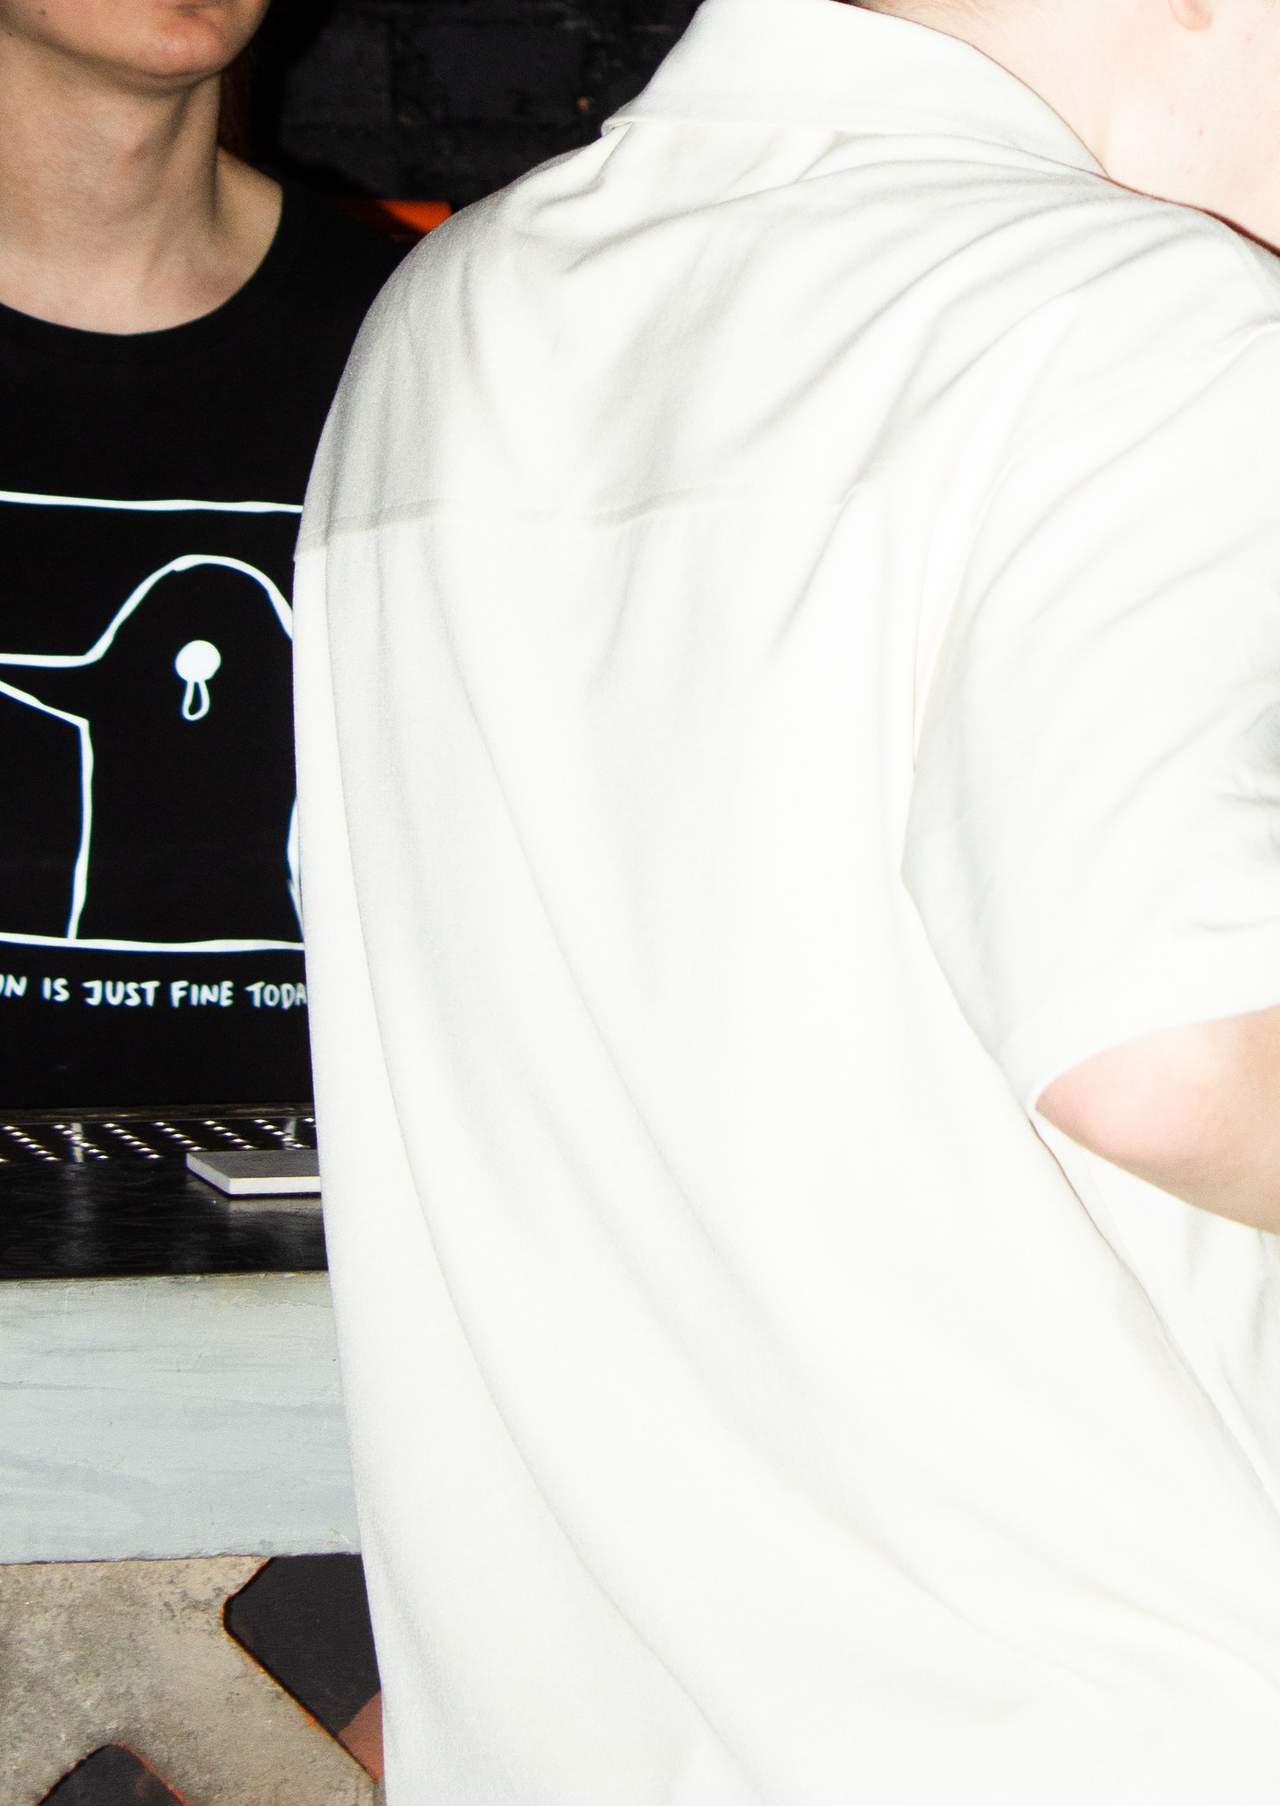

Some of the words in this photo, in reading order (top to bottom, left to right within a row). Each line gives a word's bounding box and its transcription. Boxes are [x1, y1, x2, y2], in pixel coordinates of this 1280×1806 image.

[43, 977, 70, 1002] IS
[82, 979, 160, 1007] JUST
[170, 980, 234, 1008] FINE
